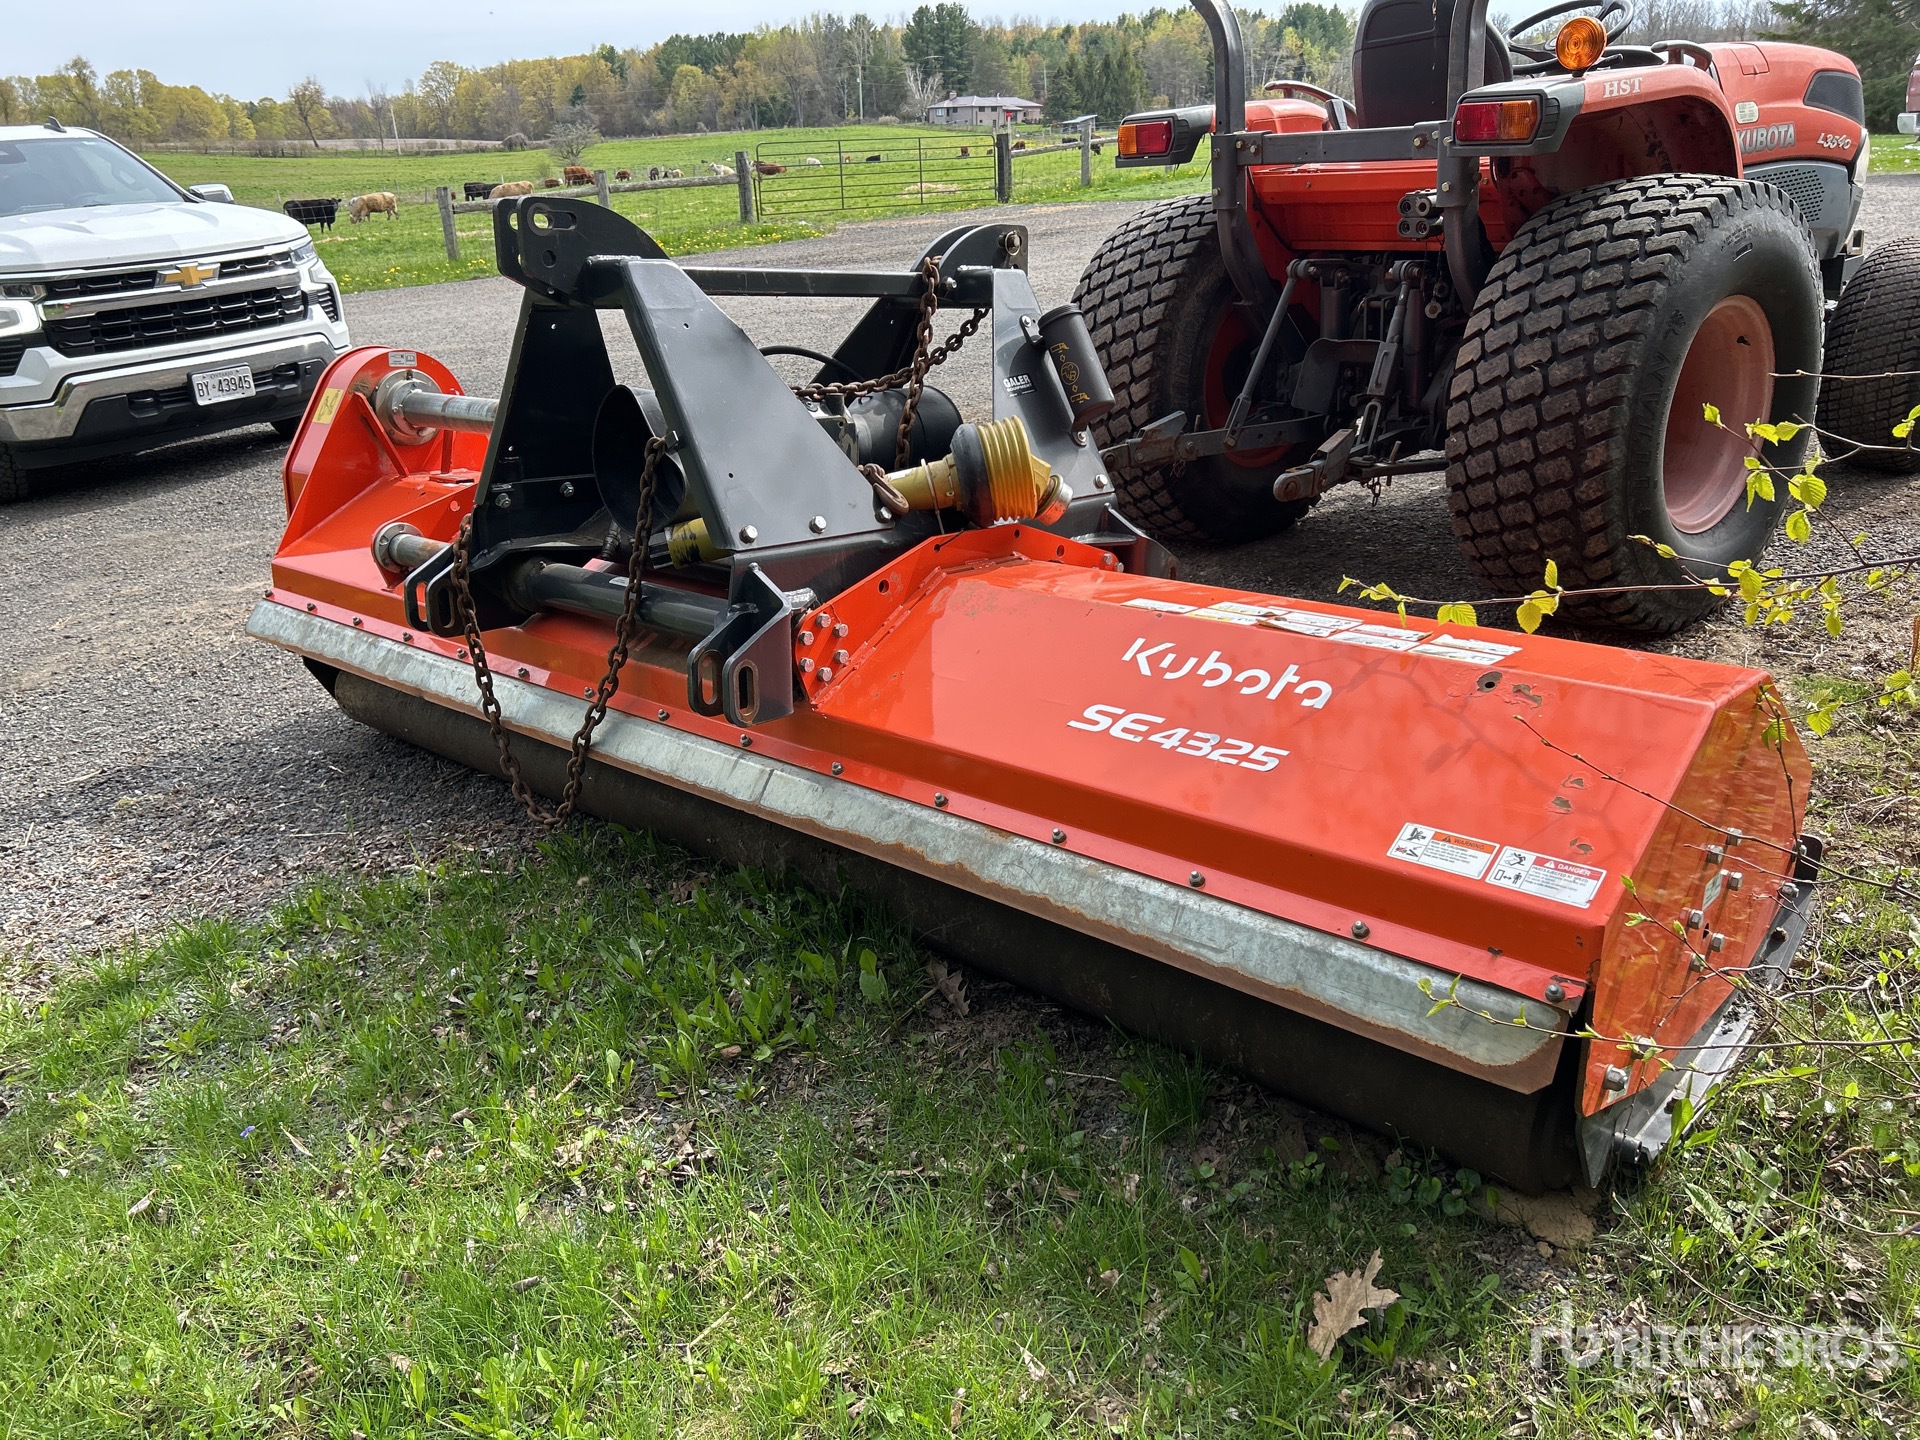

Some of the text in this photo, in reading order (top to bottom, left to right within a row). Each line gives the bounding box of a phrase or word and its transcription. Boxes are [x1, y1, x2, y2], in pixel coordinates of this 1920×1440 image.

[1603, 77, 1642, 98] HST
[1737, 123, 1795, 153] KUBOTA
[196, 380, 210, 397] BY
[218, 375, 251, 393] 43945
[1003, 374, 1031, 388] GALER
[1121, 637, 1333, 709] Kubota
[1066, 704, 1290, 772] SE4325
[1454, 838, 1485, 850] WARNING
[1557, 863, 1592, 877] DANGER
